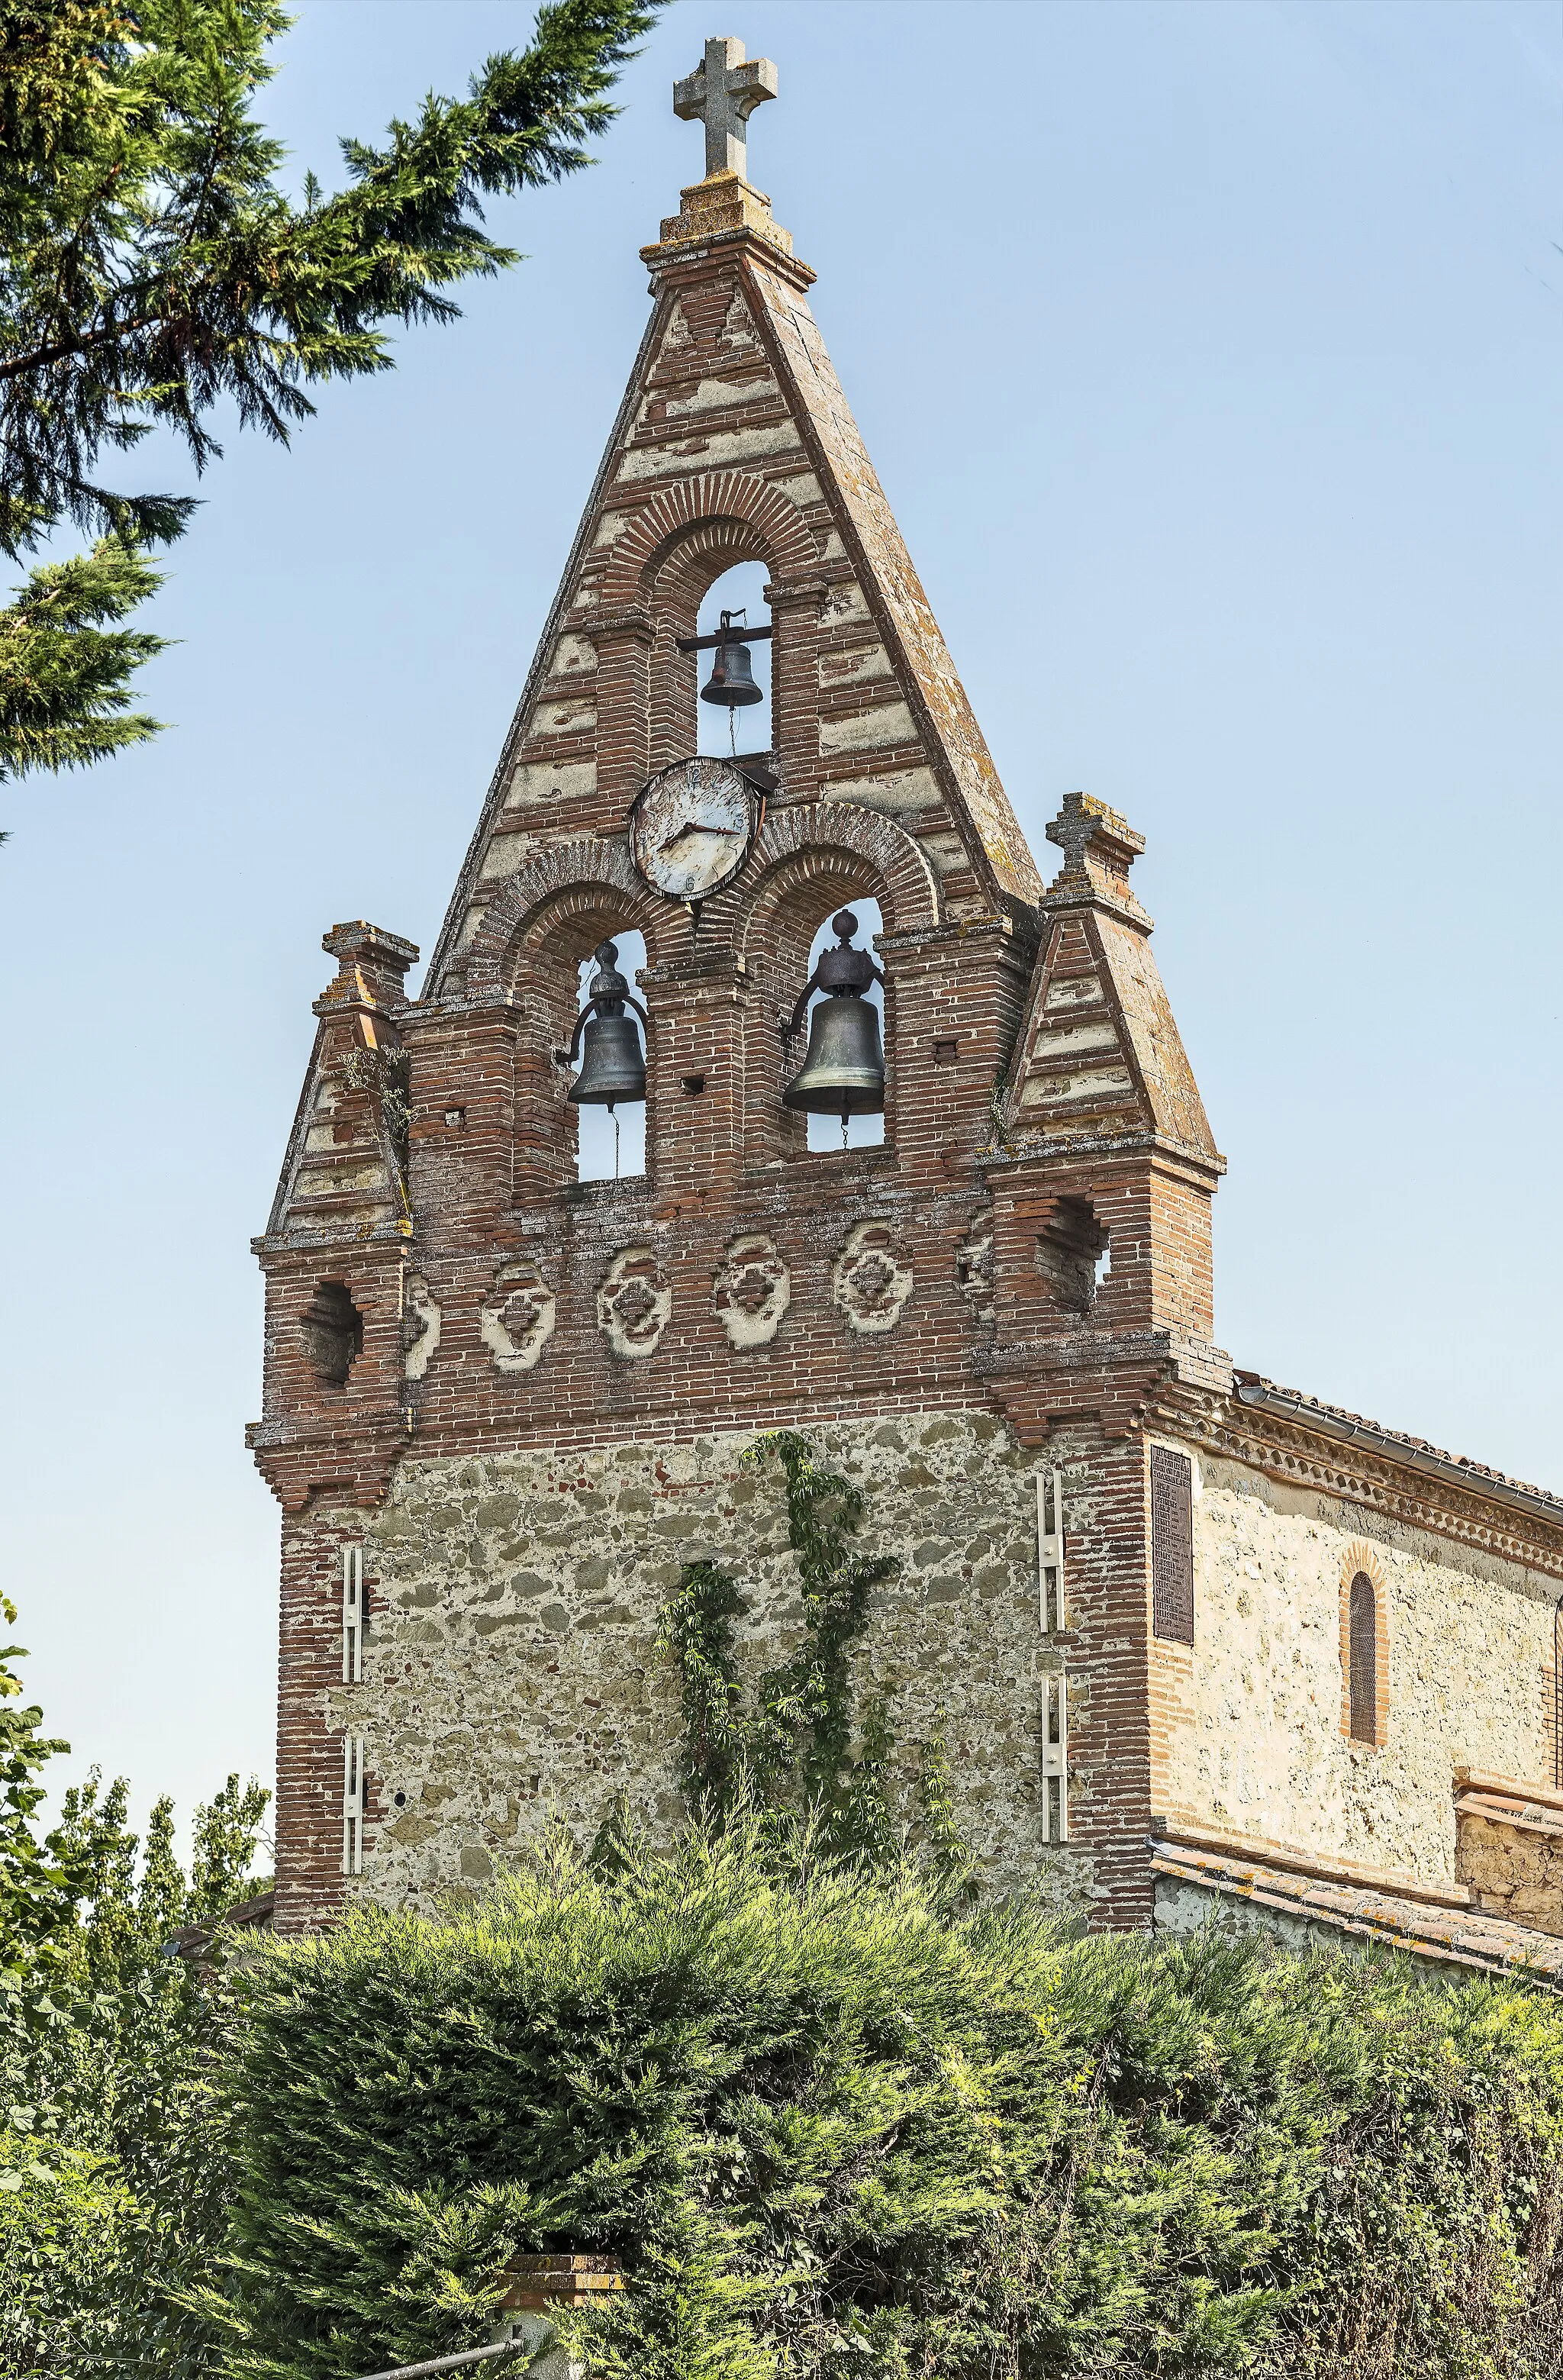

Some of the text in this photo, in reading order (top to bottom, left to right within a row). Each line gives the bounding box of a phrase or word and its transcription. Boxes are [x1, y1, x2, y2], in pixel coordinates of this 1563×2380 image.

[685, 766, 701, 784] 12
[736, 814, 745, 828] 3
[639, 830, 648, 845] 9
[685, 876, 694, 891] 6
